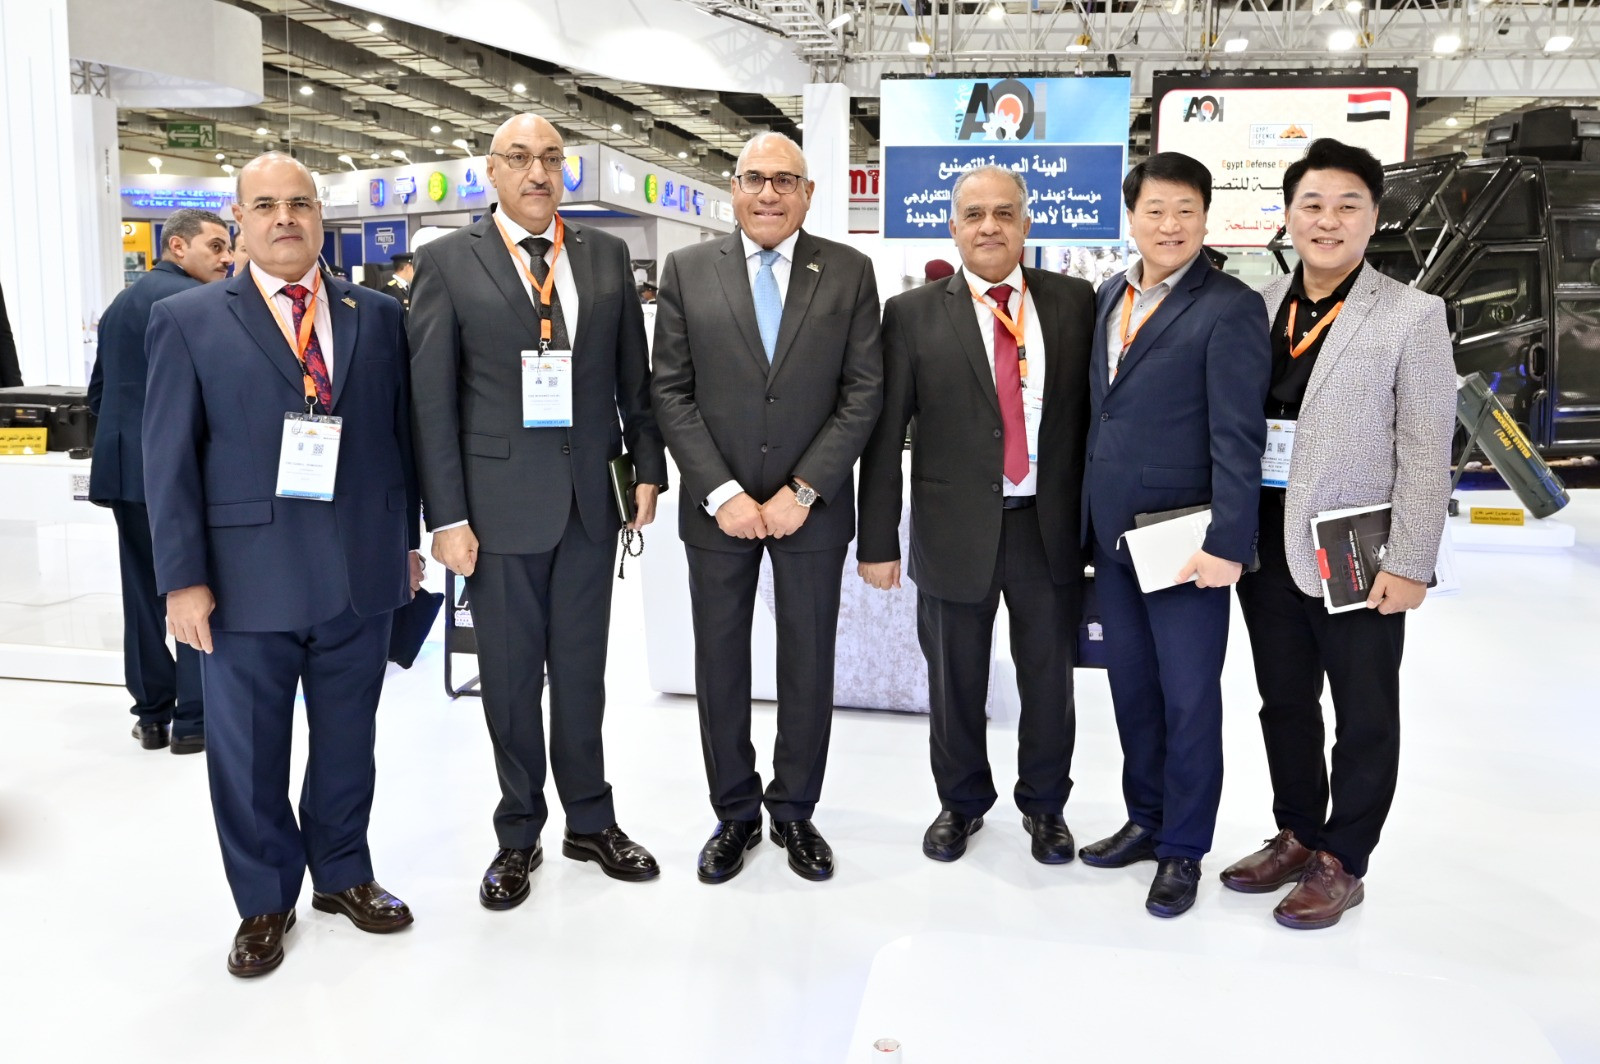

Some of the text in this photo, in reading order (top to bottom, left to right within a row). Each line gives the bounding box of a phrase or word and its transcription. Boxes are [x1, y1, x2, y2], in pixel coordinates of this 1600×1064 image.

[958, 78, 1047, 140] AOI
[1184, 95, 1225, 122] AOI
[1222, 160, 1243, 170] Egypt
[1246, 160, 1276, 168] Defense
[1211, 177, 1249, 190] للتصن
[1041, 189, 1066, 204] تهدف
[1067, 187, 1102, 204] مؤسسة
[906, 207, 948, 228] الجديدة
[1028, 205, 1058, 225] لأهدا
[1062, 205, 1099, 228] تحقيقاً
[1492, 409, 1516, 439] ROCKETRY
[1513, 436, 1532, 459] SYSTEM
